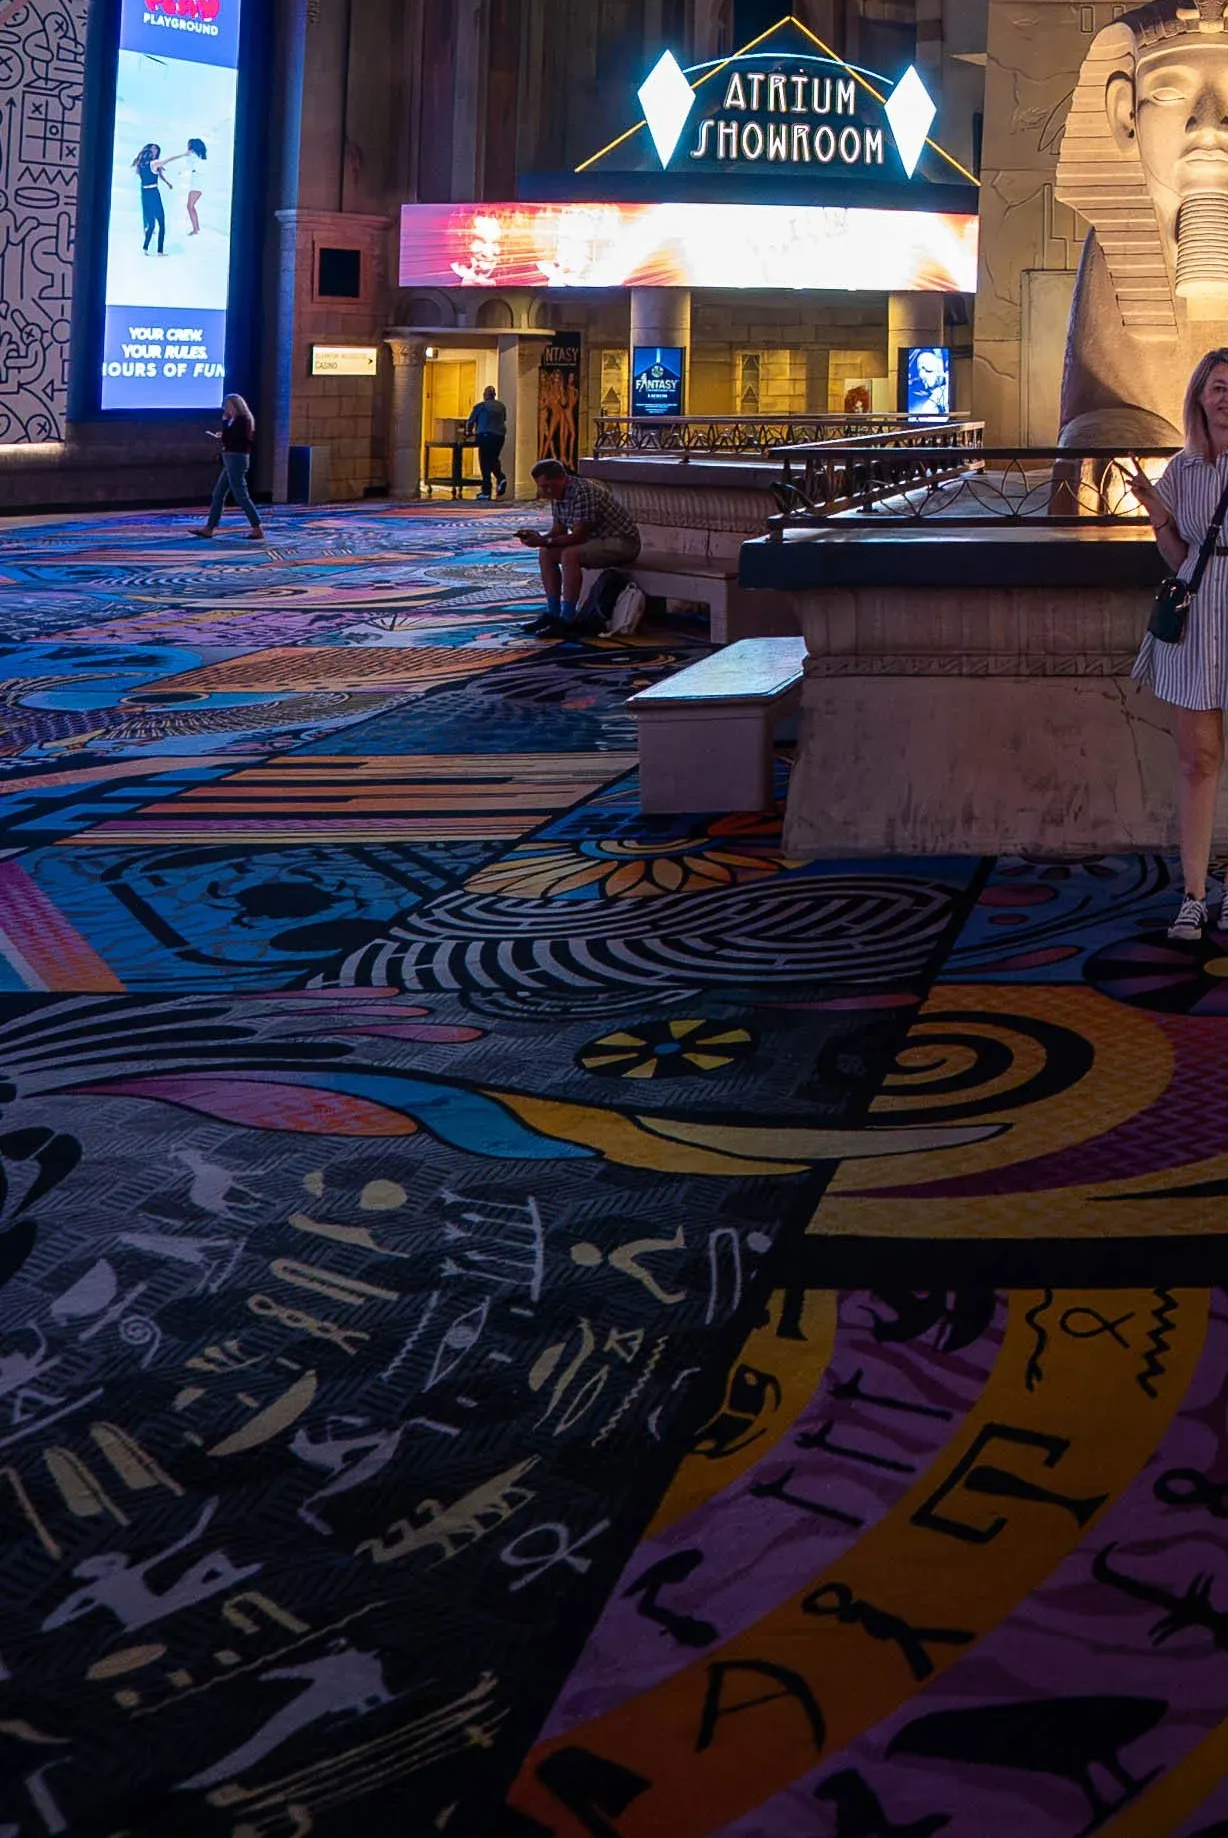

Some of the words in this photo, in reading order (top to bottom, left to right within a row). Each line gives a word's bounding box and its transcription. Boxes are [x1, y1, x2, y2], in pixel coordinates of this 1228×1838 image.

[143, 12, 219, 36] PLAYGROUND
[723, 71, 857, 115] ATRIUM
[690, 118, 885, 165] SHOWROOM
[128, 327, 164, 341] YOUR
[121, 344, 162, 359] YOUR
[545, 346, 579, 363] NTASY
[163, 362, 187, 378] OF
[635, 374, 680, 392] FANTASY
